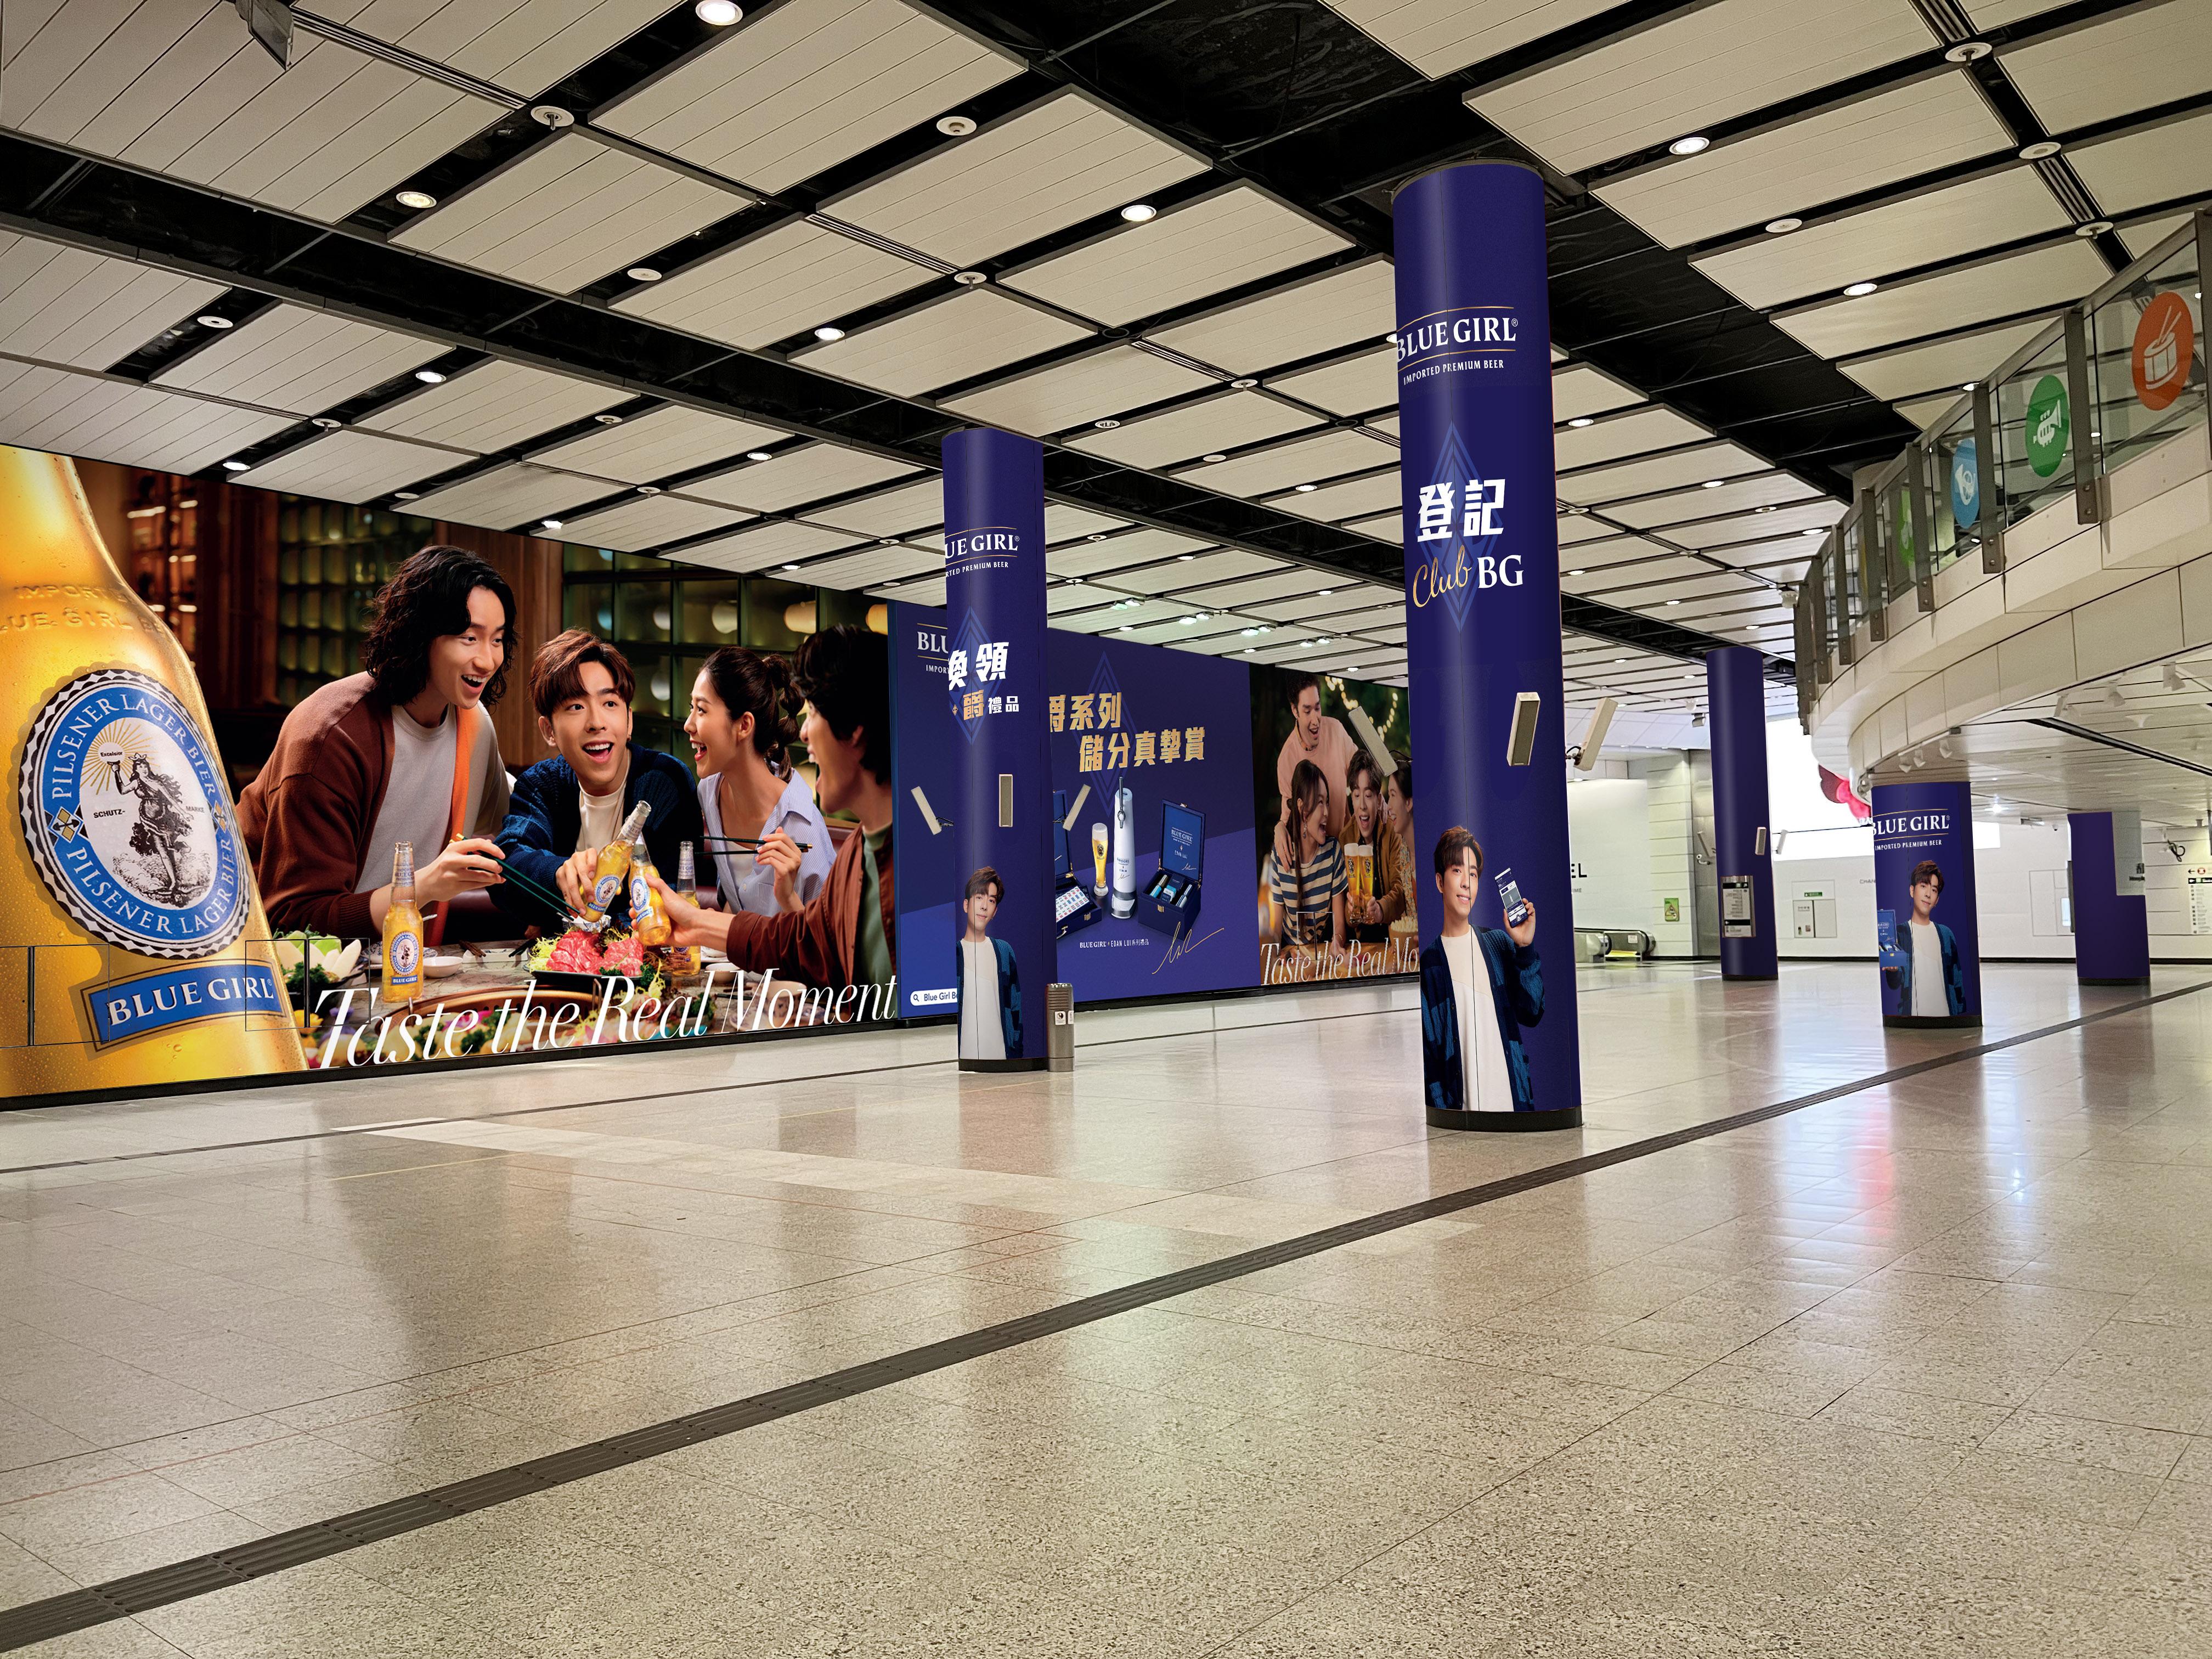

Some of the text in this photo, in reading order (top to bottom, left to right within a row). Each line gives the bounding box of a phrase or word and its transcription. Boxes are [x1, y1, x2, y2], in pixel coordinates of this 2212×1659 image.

[1397, 321, 1449, 363] BLUE
[1403, 359, 1504, 386] IMPORTED PREMIUM BEER
[1417, 478, 1506, 543] 登記
[945, 538, 968, 559] UE
[946, 568, 961, 578] RTED
[962, 562, 992, 573] PREMIUM
[1412, 544, 1524, 608] Club BG
[917, 631, 949, 654] BLU
[52, 694, 218, 799] PILSENER LAGER BIER
[1875, 843, 1901, 851] IMPORTED
[66, 838, 233, 934] PILSENER LAGER BIER
[1260, 943, 1312, 986] Taste
[1315, 940, 1344, 981] the
[1345, 937, 1389, 978] Real
[1389, 936, 1420, 974] Mo
[108, 981, 202, 1026] BLUE
[924, 993, 938, 1002] Blue
[939, 991, 950, 1000] Girl
[309, 967, 898, 1070] Taste the Real Moment
